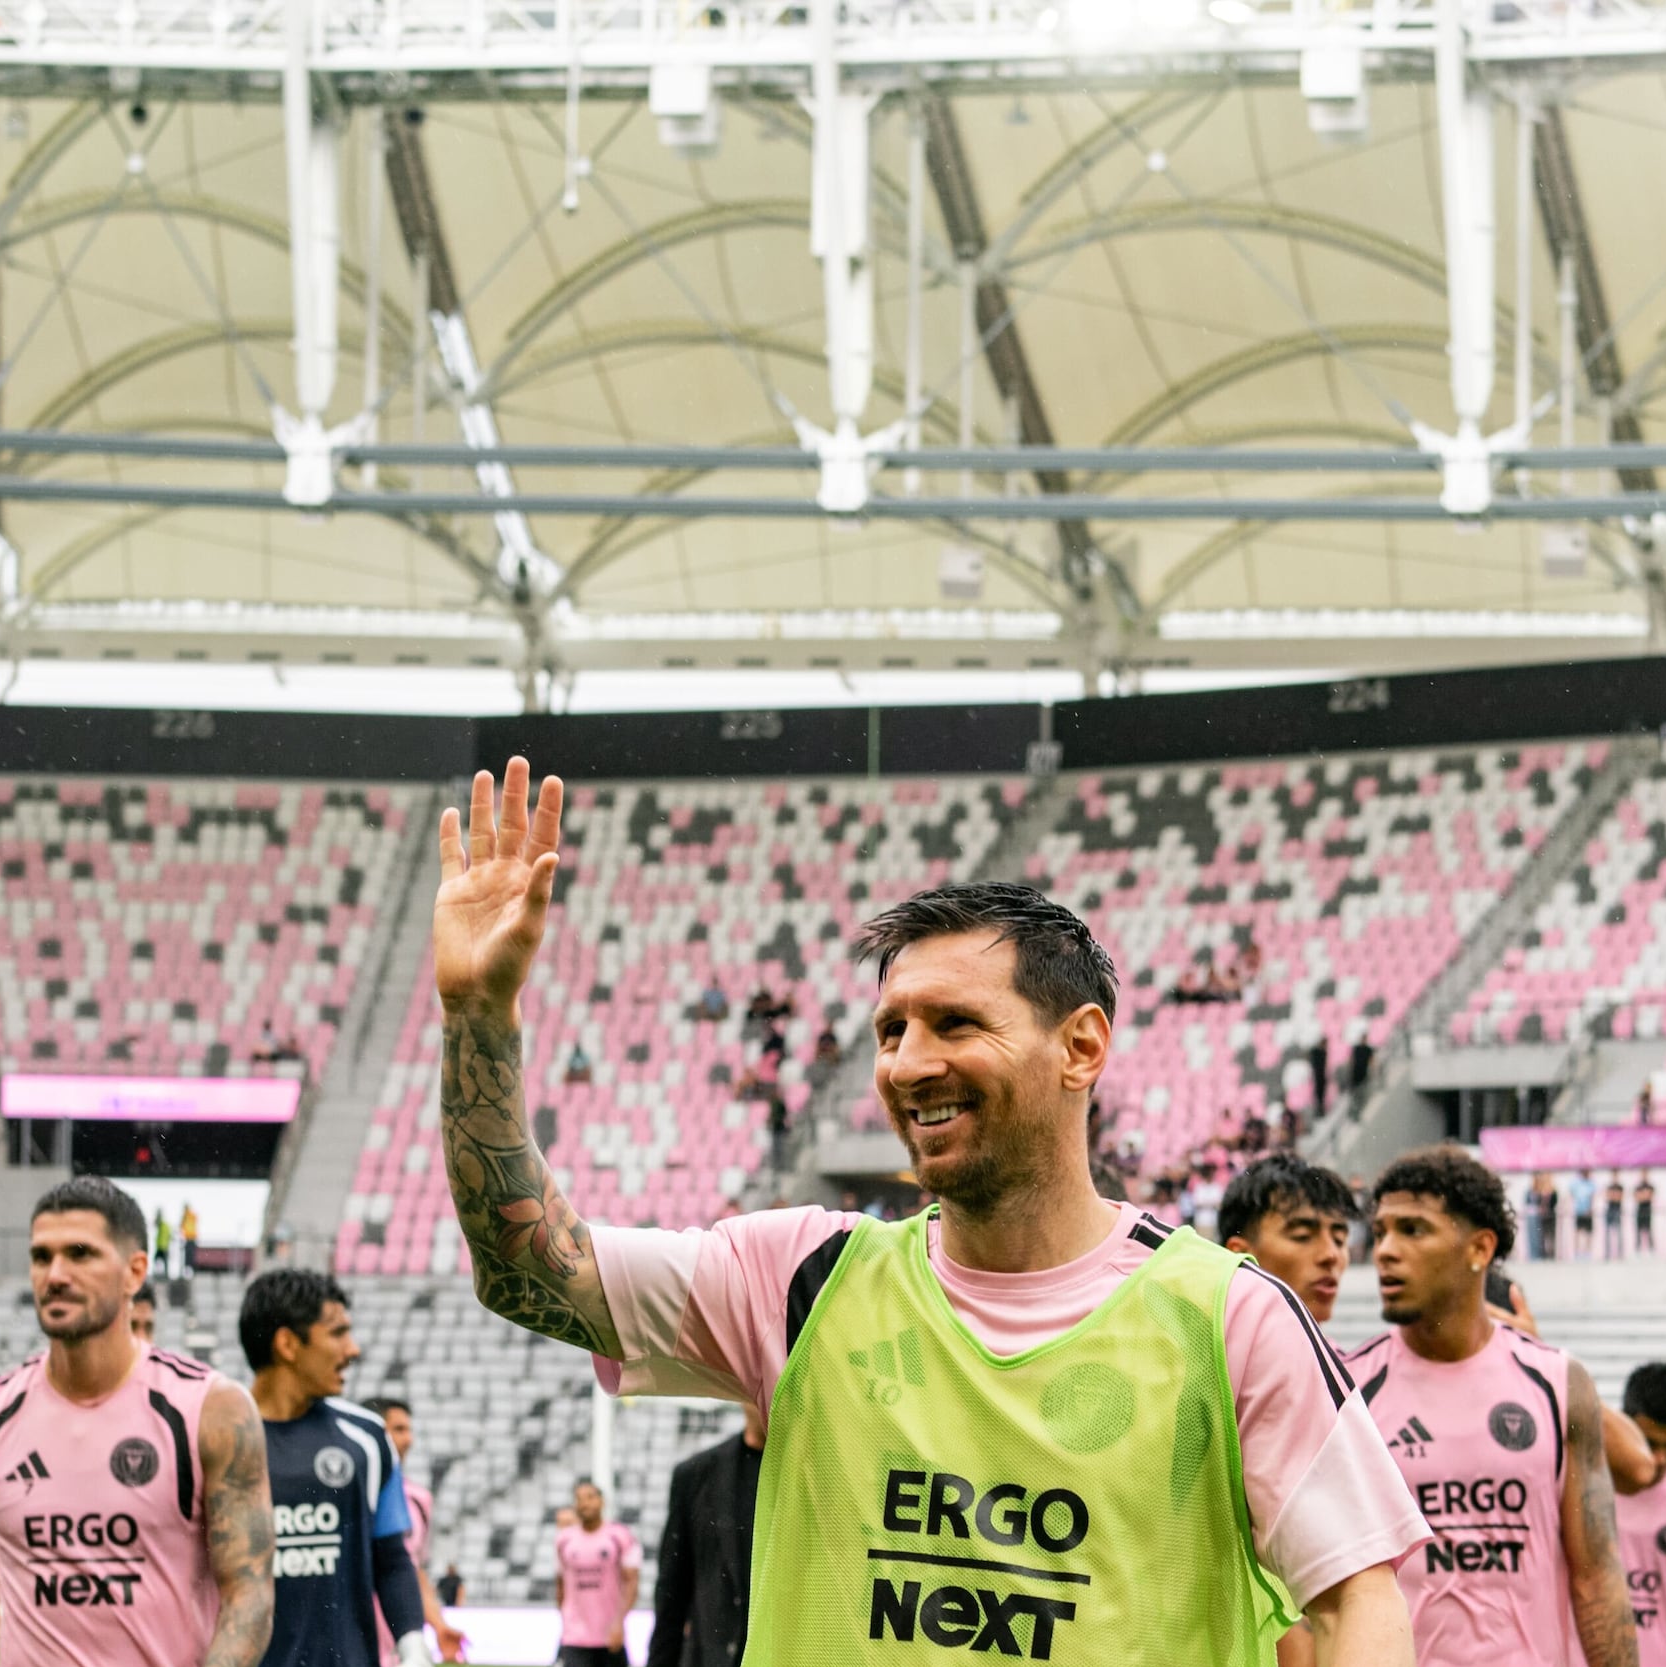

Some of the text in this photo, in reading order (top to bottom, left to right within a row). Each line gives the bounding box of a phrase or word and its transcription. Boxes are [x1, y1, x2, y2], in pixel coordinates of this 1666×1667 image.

[1327, 677, 1391, 713] 224
[1403, 1445, 1427, 1460] 41
[882, 1468, 1091, 1555] ERGO
[1416, 1477, 1528, 1516] ERGO
[23, 1512, 139, 1549] ERGO
[274, 1501, 341, 1535] RGO
